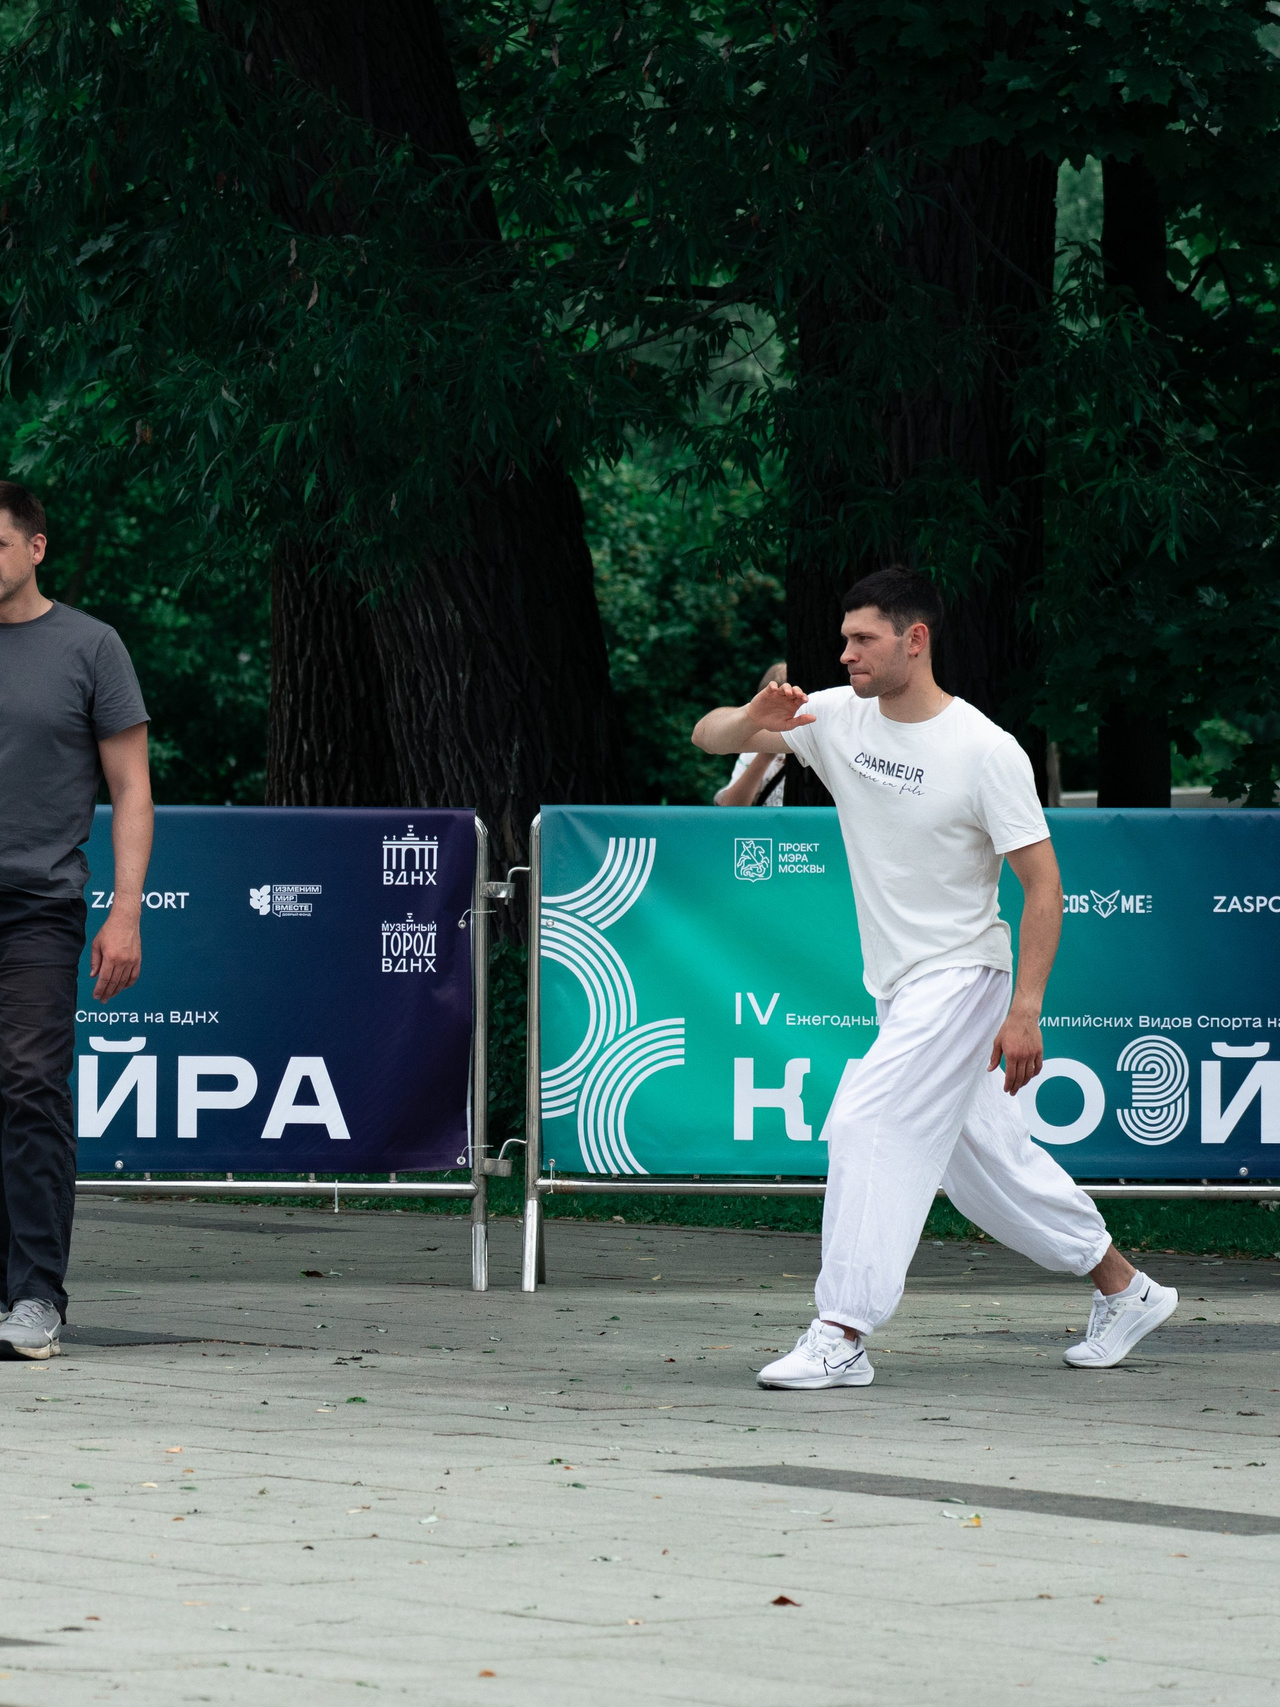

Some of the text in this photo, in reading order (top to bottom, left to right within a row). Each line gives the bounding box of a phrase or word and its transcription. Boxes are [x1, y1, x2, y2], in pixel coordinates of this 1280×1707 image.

[854, 751, 925, 784] CHARMEUR
[778, 843, 820, 852] ПРОЕКТ
[778, 853, 809, 863] МЭРА
[778, 864, 825, 874] МОСКВЫ
[383, 871, 438, 886] ВДНХ
[381, 932, 437, 957] ГОРОД
[381, 958, 437, 973] ВДНХ
[75, 1010, 139, 1025] Спорта
[144, 1011, 165, 1023] на
[170, 1011, 219, 1025] ВДНХ
[735, 992, 781, 1026] IV
[1138, 1014, 1193, 1030] Видов
[1197, 1014, 1262, 1031] Спорта
